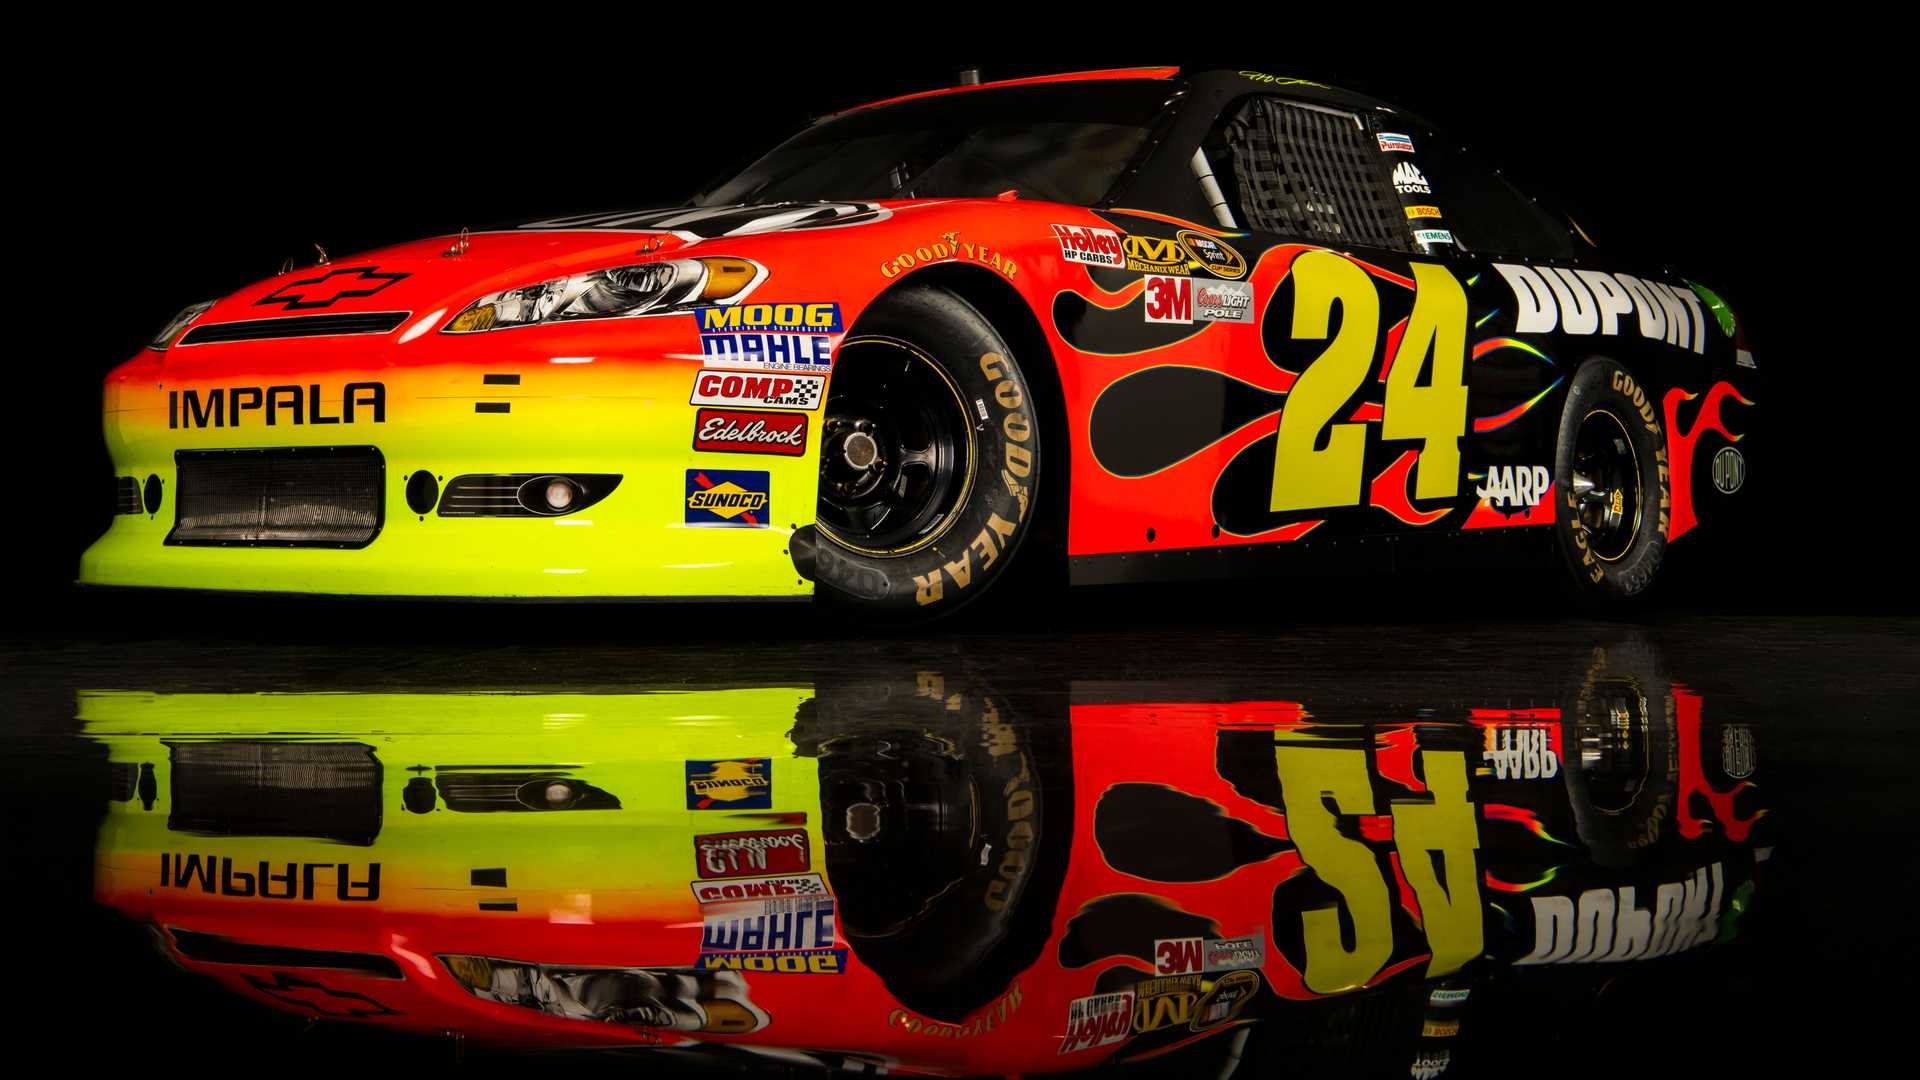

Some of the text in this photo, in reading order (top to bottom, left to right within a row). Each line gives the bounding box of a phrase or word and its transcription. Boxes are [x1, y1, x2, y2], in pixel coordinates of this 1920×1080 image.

[1393, 162, 1428, 185] MAC
[1395, 185, 1431, 194] TOOLS
[1417, 208, 1440, 216] BOSCH
[1053, 224, 1123, 264] Holley
[1065, 250, 1112, 264] HP CARBS
[1127, 259, 1190, 275] MECHANIX WEAR
[1147, 277, 1192, 320] 3M
[1222, 295, 1249, 308] LIGHT
[1492, 263, 1705, 354] DUPONT
[704, 303, 834, 329] MOOG
[1204, 309, 1243, 319] POLE
[701, 334, 831, 366] MAHLE
[763, 362, 832, 373] ENGINE BEARINGS
[698, 375, 793, 399] COMP
[1270, 250, 1468, 512] 24
[169, 382, 385, 429] IMPALA
[763, 396, 808, 405] CAMS
[699, 417, 802, 446] Edelbrock
[1486, 465, 1550, 507] AARP
[692, 493, 762, 508] SUNOCO
